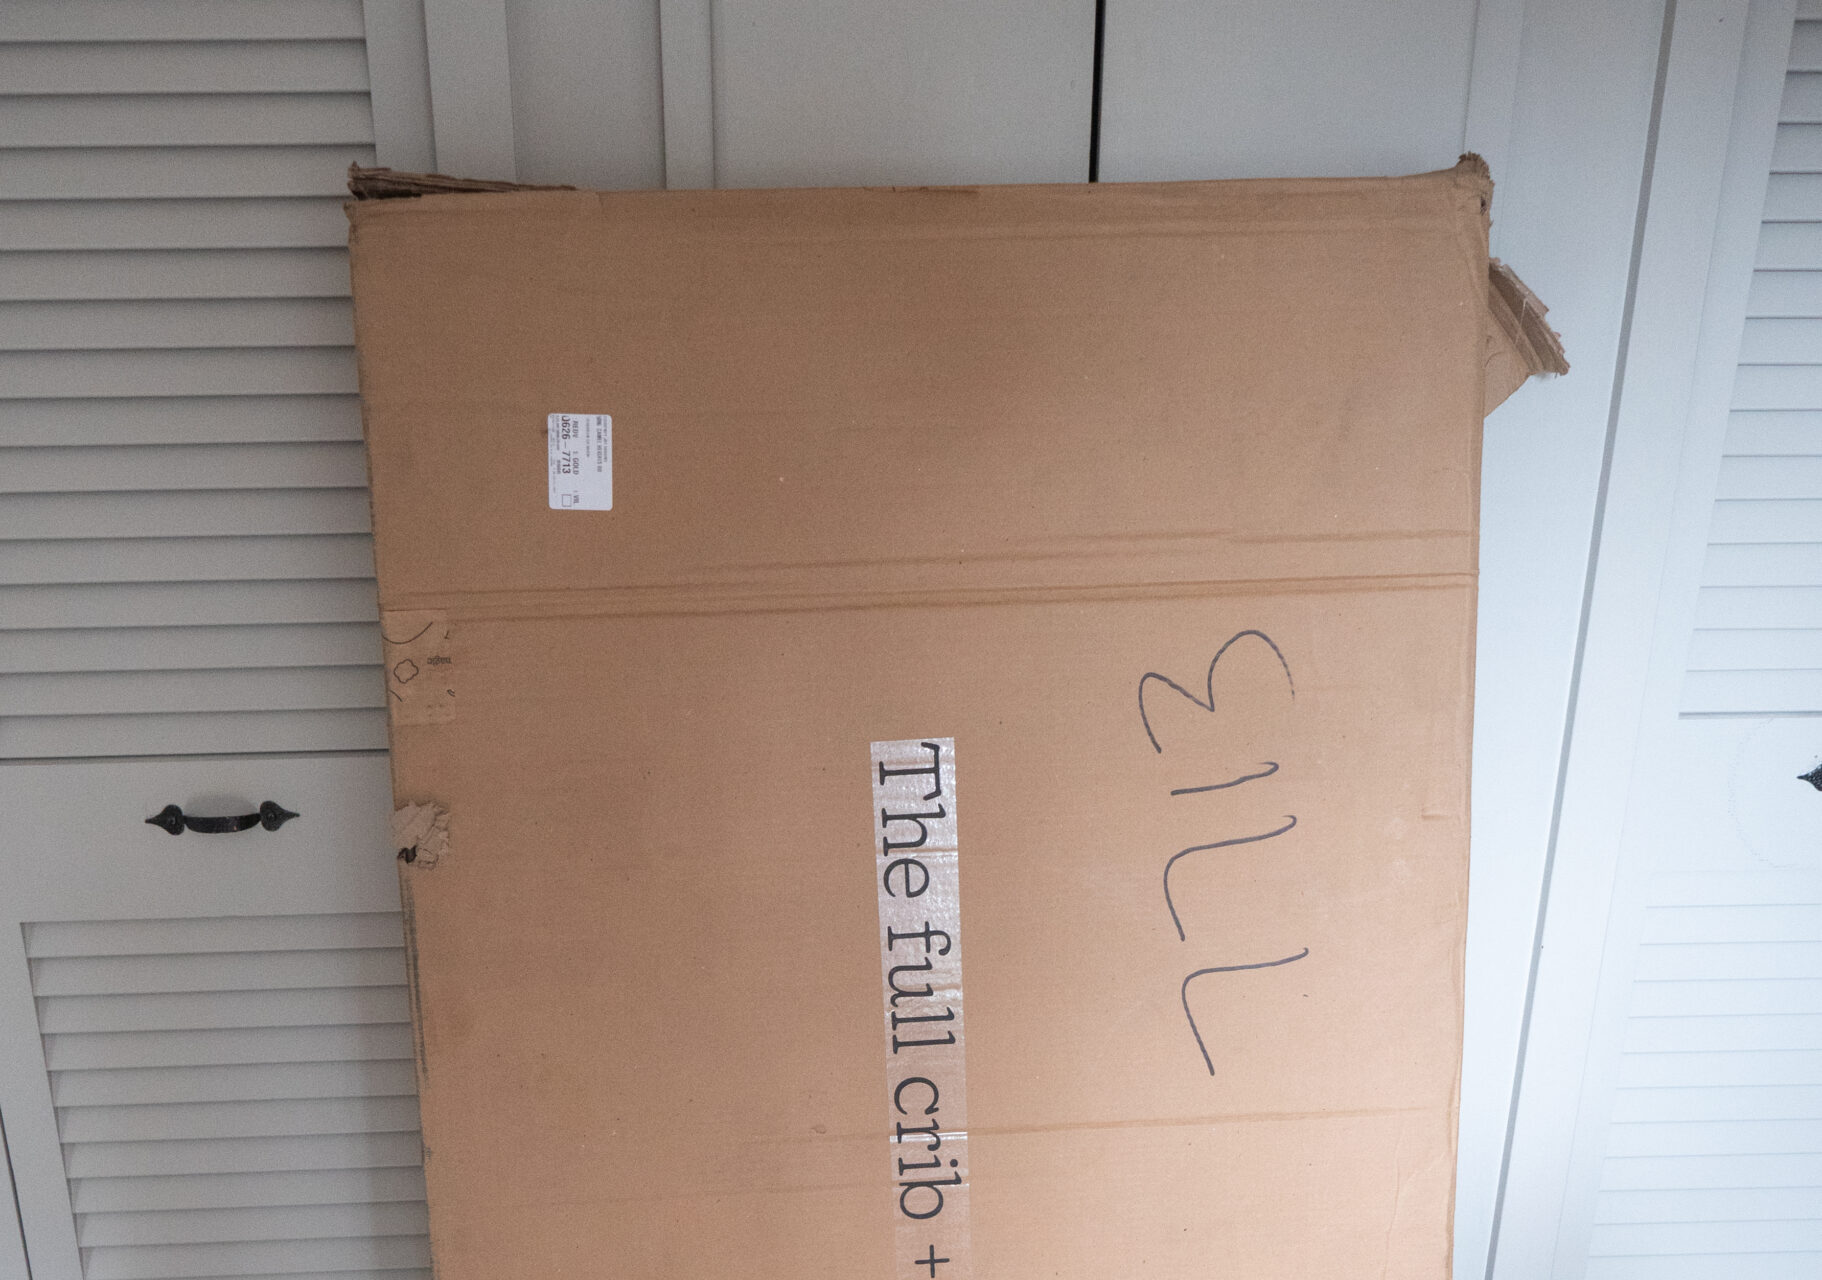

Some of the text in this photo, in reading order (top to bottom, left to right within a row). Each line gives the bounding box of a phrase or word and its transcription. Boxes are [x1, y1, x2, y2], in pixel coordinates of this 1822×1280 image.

[878, 741, 947, 899] The
[1138, 628, 1309, 1076] 7713
[886, 920, 957, 1055] full
[893, 1075, 963, 1220] crib
